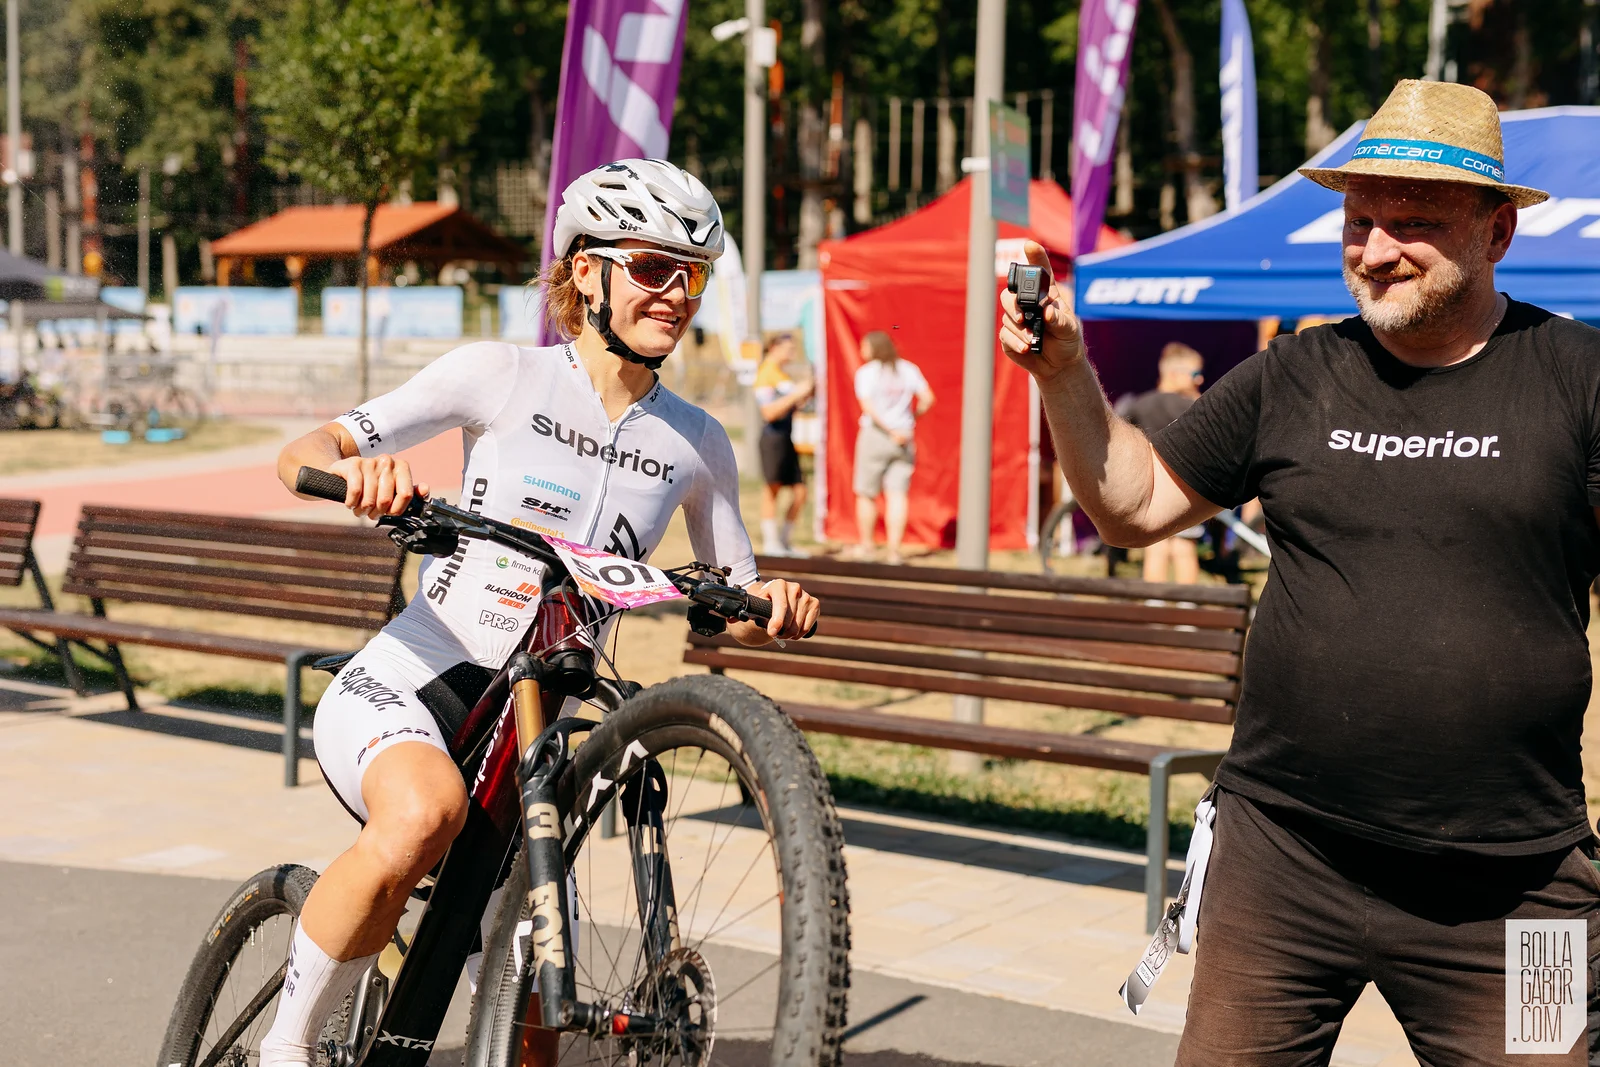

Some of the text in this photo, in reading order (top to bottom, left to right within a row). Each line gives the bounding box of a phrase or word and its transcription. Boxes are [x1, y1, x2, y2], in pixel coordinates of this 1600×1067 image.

[1328, 429, 1500, 461] superior.
[523, 475, 581, 501] SHIMANO
[570, 557, 655, 586] 501
[484, 583, 532, 603] BLACHDOM
[499, 598, 523, 609] PLUS
[528, 881, 566, 977] FOX
[377, 1029, 435, 1051] XTR
